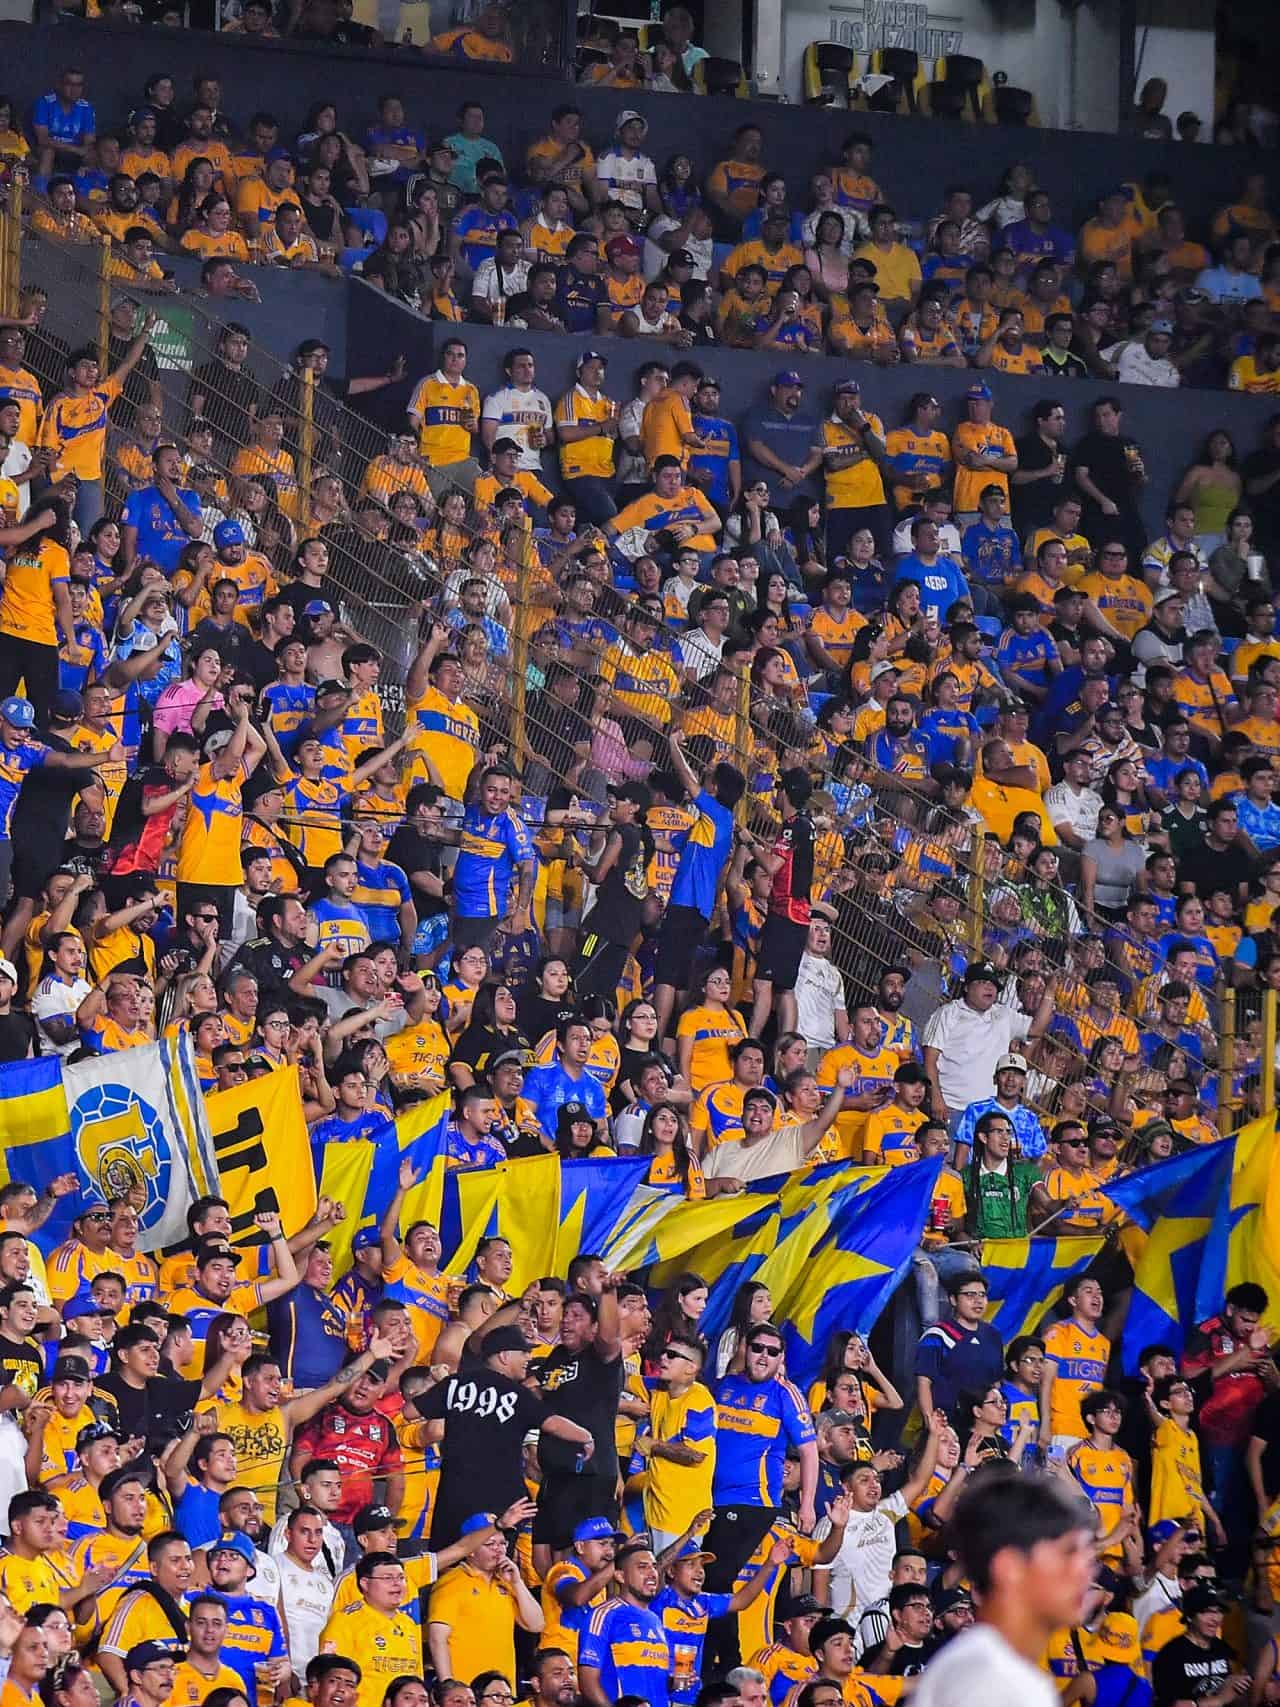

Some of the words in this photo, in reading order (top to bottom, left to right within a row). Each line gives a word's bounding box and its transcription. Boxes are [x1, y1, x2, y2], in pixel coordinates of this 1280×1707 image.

[864, 0, 927, 27] RANCHO
[830, 20, 864, 50] LOS
[447, 1379, 519, 1424] 1998
